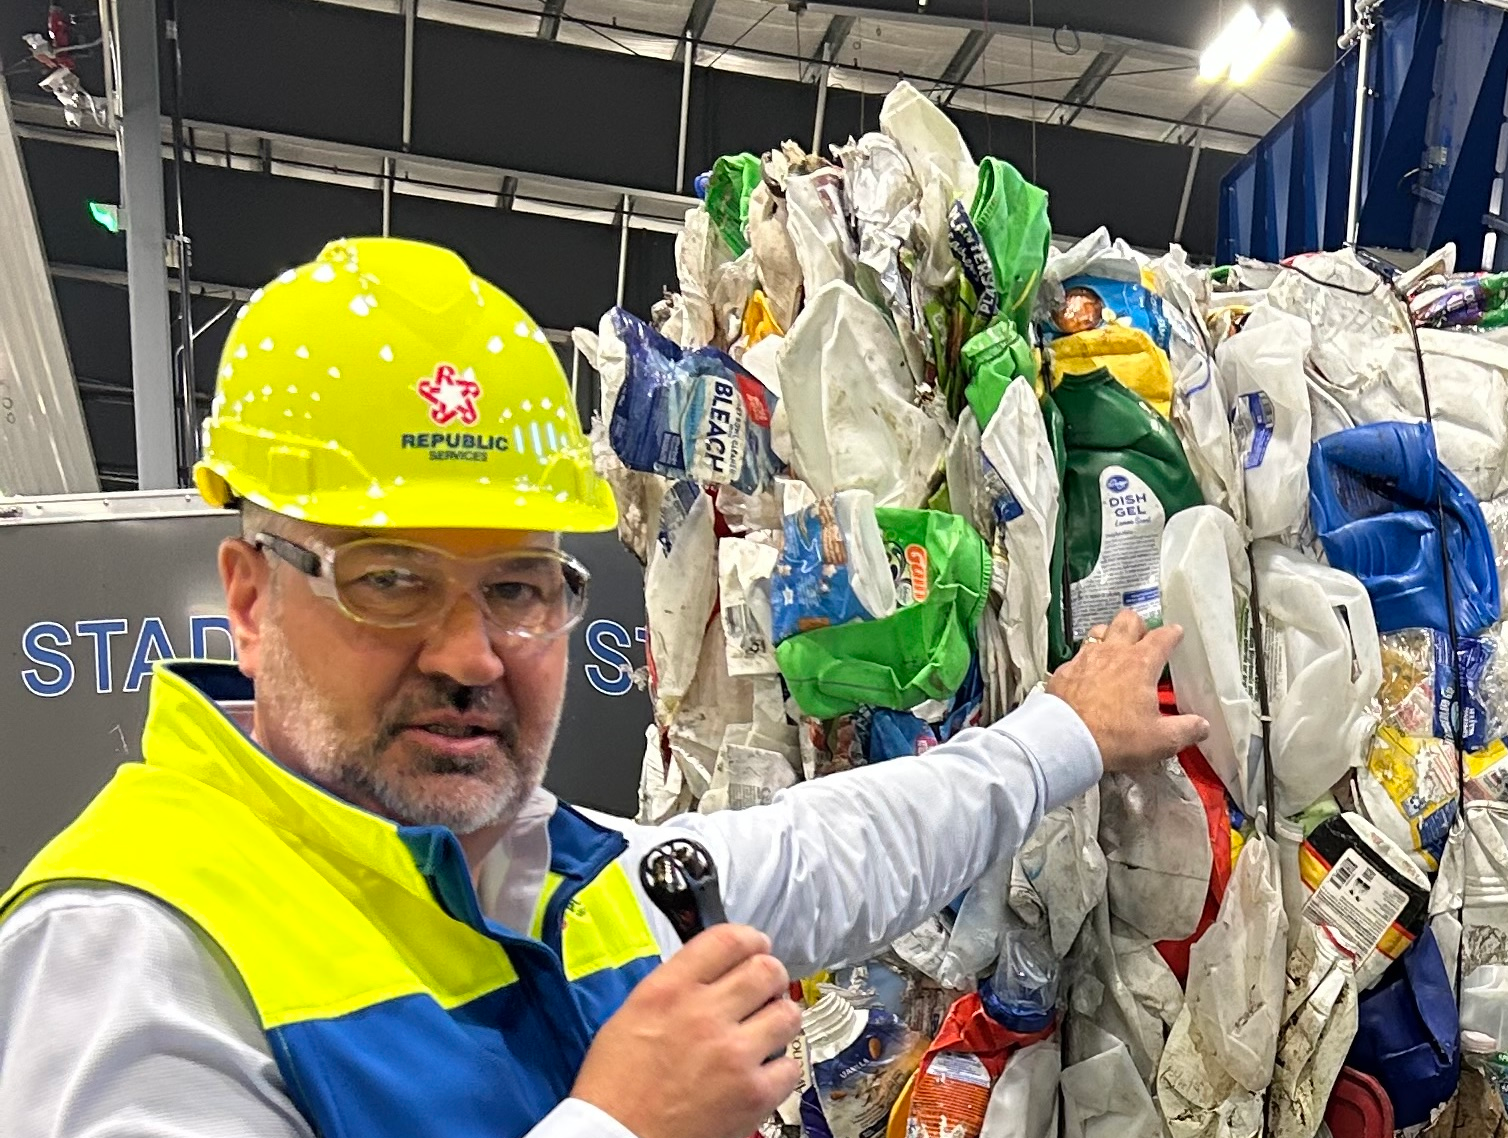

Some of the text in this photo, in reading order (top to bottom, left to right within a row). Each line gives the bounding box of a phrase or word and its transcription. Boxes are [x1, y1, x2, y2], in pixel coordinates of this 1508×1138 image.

[705, 381, 733, 473] BLEACH
[401, 433, 508, 452] REPUBLIC
[429, 450, 488, 462] SERVICES
[1109, 493, 1147, 507] DISH
[1114, 505, 1146, 517] GEL
